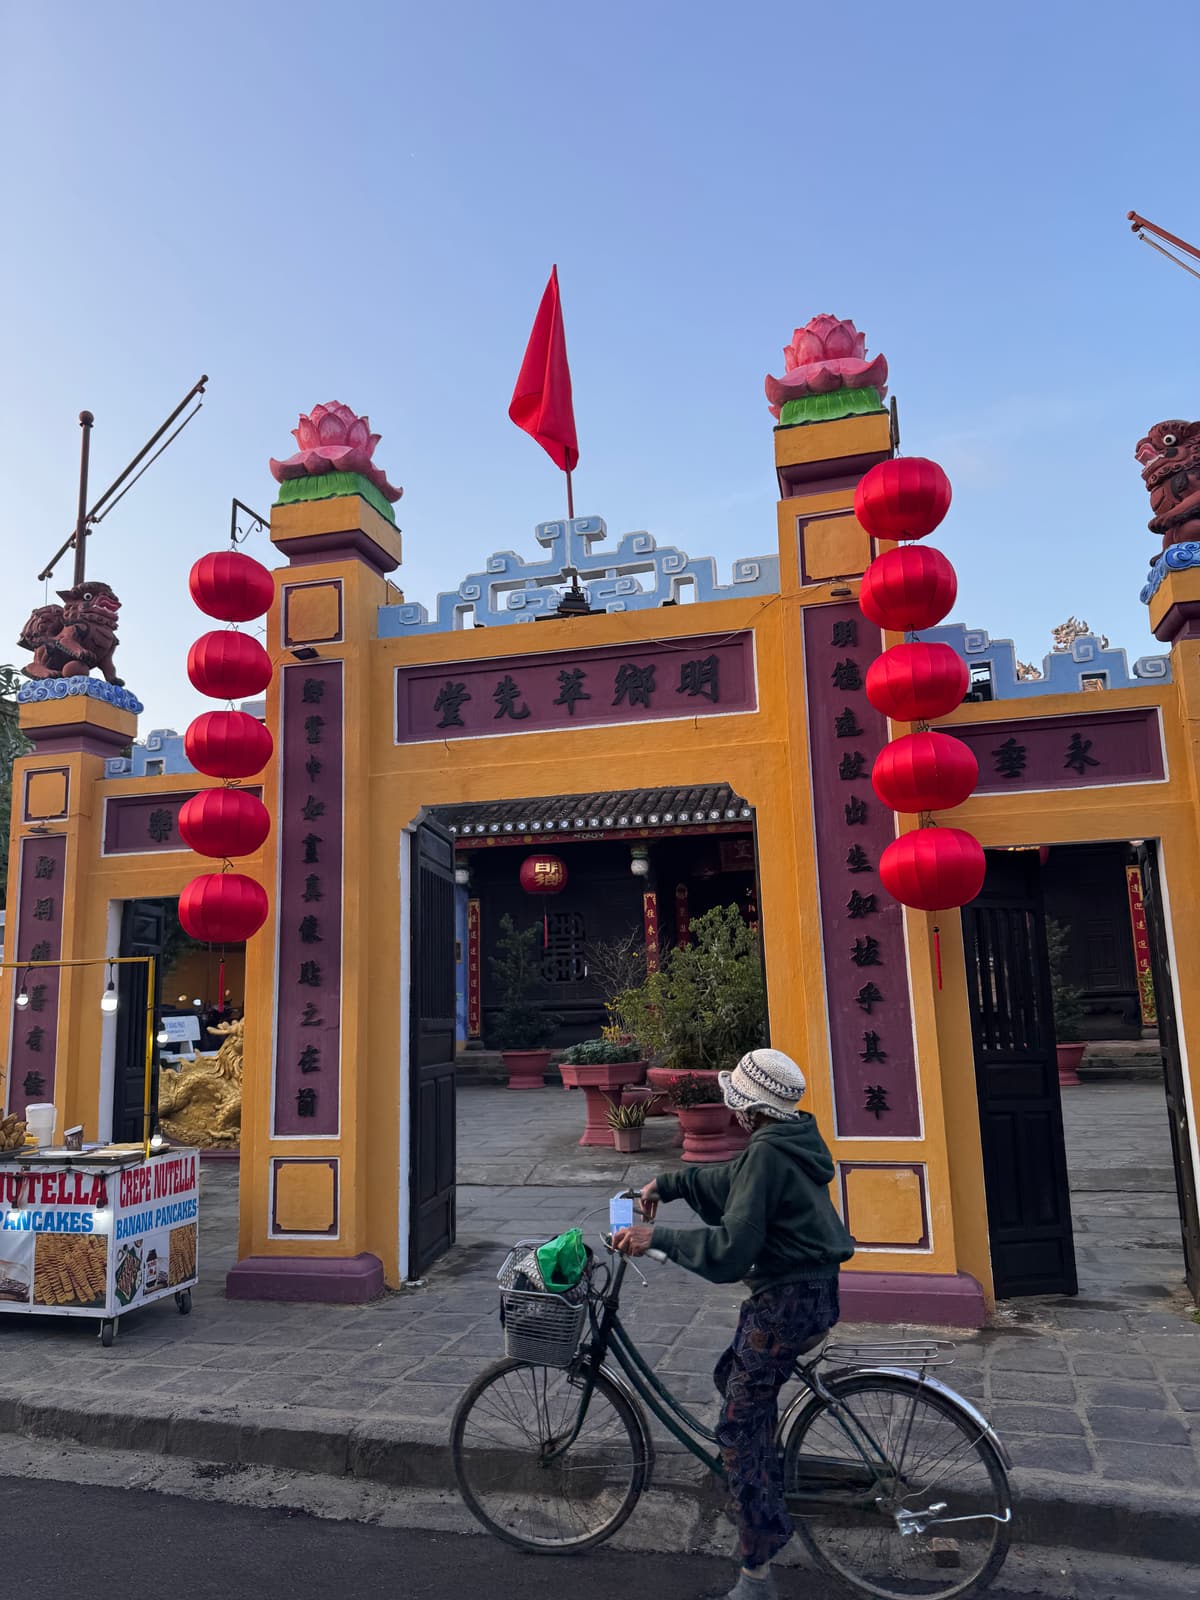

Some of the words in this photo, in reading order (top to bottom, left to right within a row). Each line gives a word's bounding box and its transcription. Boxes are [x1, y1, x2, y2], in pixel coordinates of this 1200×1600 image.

[120, 1166, 151, 1208] CREPE
[154, 1156, 195, 1199] NUTELLA
[116, 1211, 153, 1240] BANANA
[155, 1198, 197, 1228] PANCAKES
